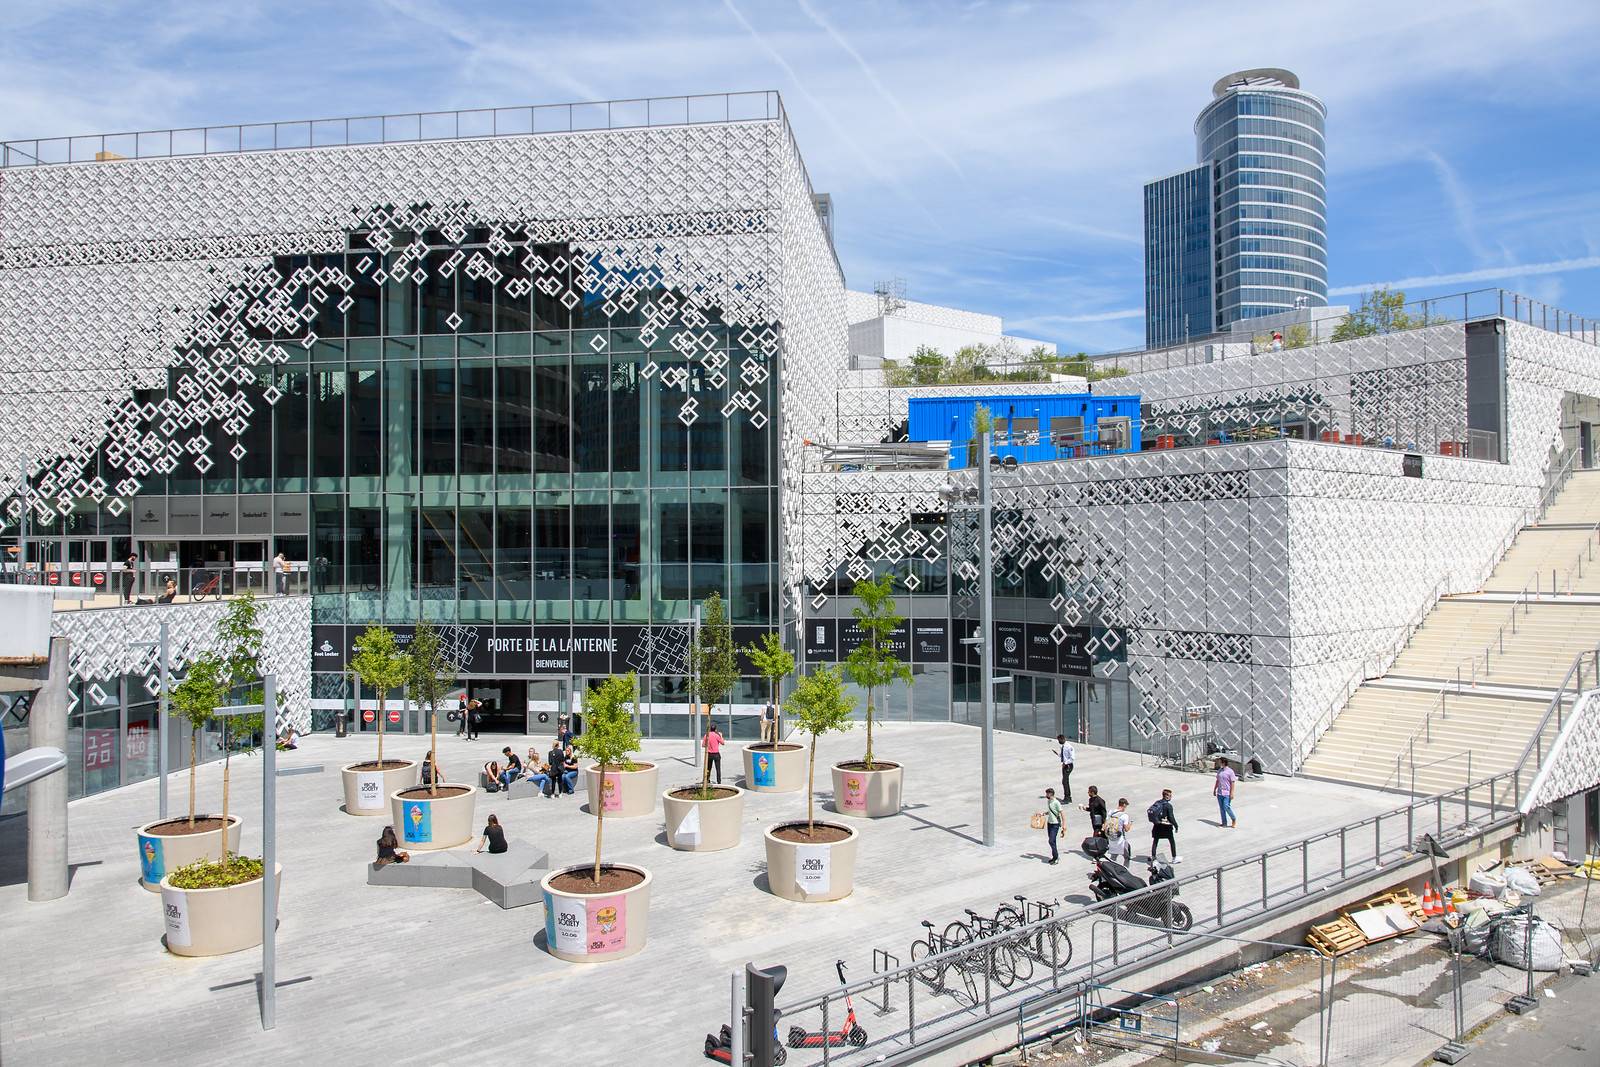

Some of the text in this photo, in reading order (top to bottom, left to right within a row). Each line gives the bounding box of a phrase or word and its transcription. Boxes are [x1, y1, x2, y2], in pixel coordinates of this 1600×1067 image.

[487, 638, 618, 652] PORTE DE LA LANTERNE
[535, 659, 569, 669] BIENVENUE
[558, 918, 580, 927] SOCIETY
